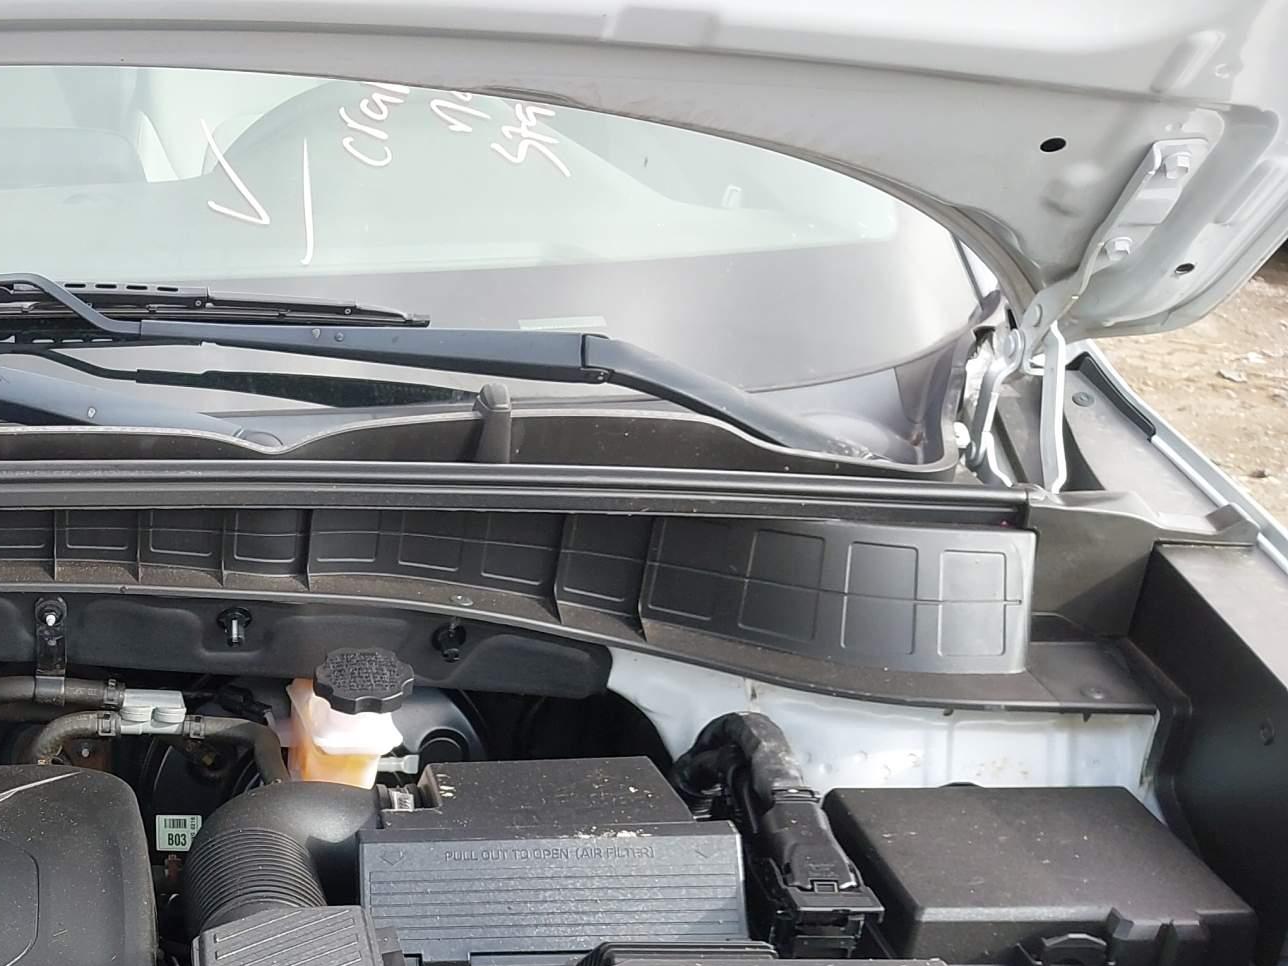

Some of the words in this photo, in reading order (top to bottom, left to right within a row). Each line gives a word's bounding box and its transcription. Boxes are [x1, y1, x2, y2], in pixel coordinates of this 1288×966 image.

[167, 833, 187, 846] B03
[444, 850, 478, 862] PULL
[481, 850, 508, 861] OUT
[513, 849, 530, 860] TO
[533, 848, 569, 860] OPEN
[575, 847, 603, 860] (AIR
[606, 847, 655, 859] FILTER)
